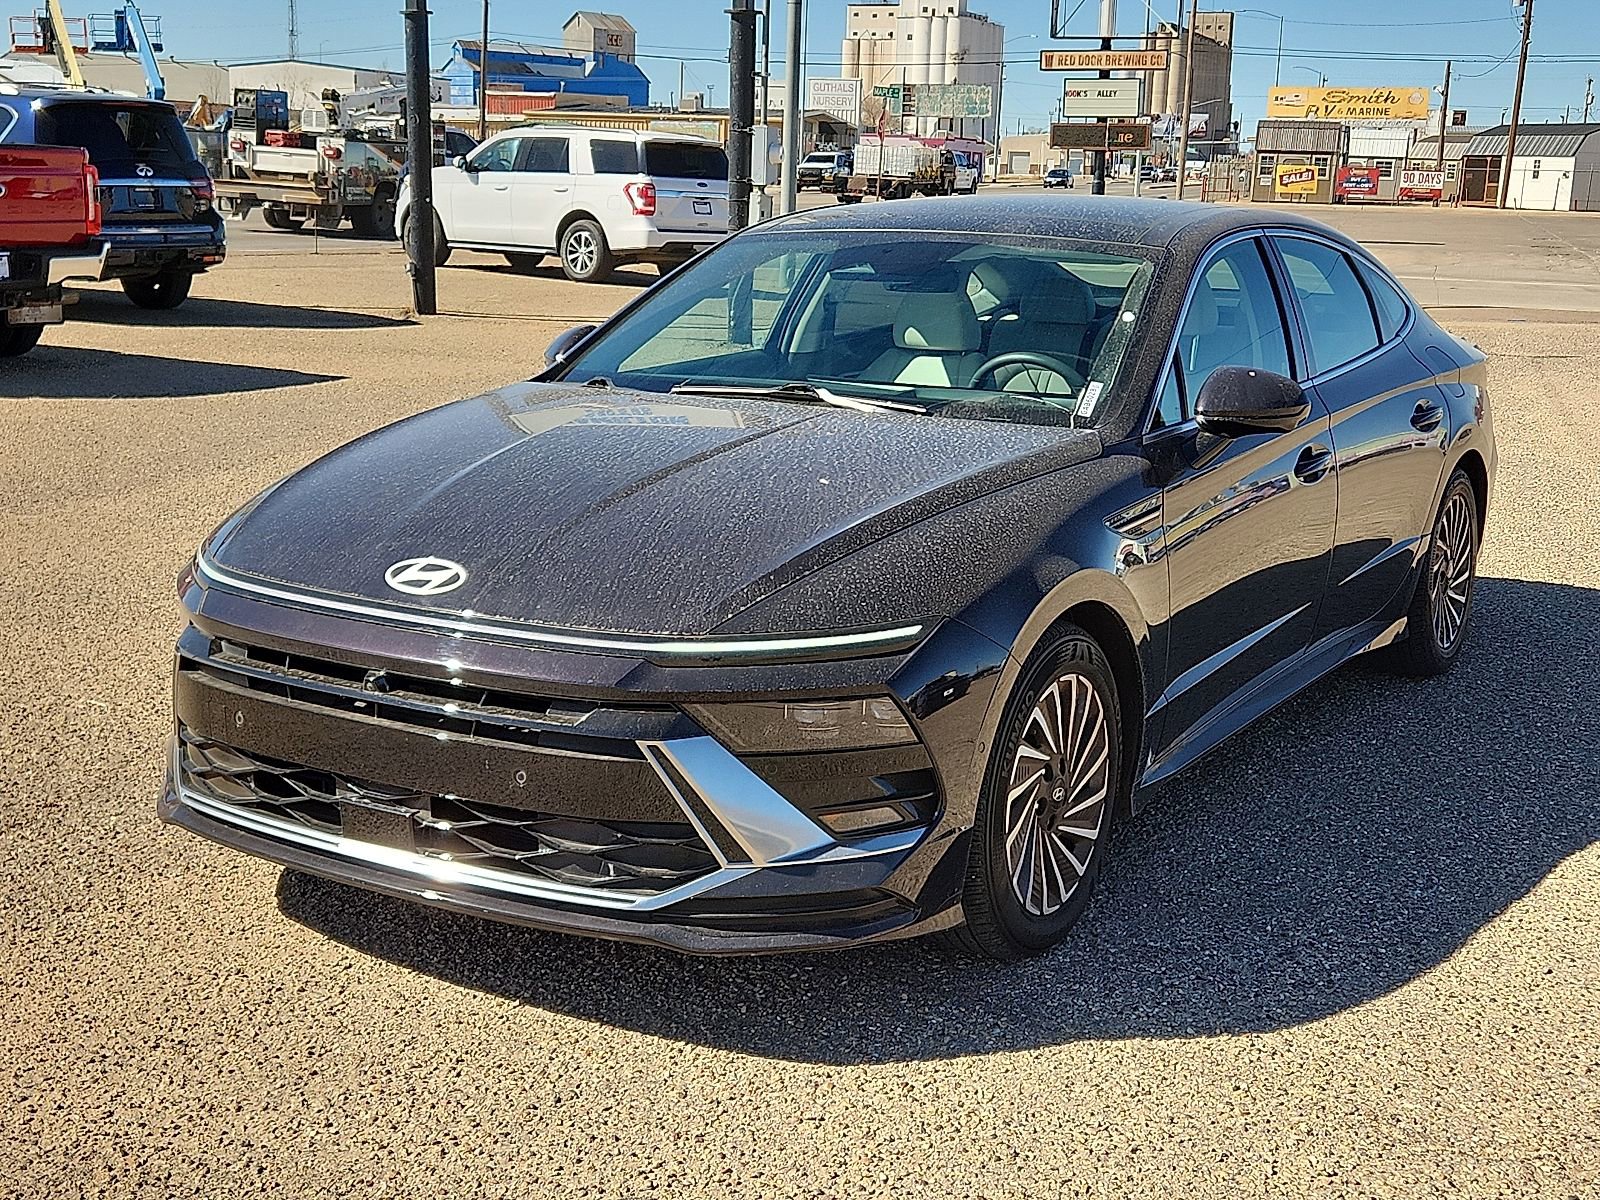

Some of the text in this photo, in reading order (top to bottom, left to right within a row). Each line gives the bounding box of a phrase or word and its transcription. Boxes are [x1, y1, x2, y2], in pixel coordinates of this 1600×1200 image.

[1058, 54, 1165, 66] RED DOOR BREWING CO.
[813, 82, 854, 92] GUTHALS
[874, 88, 893, 97] MAPLE
[1096, 90, 1118, 98] ALLEY
[1321, 88, 1401, 105] Smith
[812, 96, 853, 106] NURSERY
[1345, 107, 1391, 116] MARINE
[1282, 171, 1313, 185] SALE!
[1402, 172, 1442, 185] 90 DAYS
[1002, 690, 1033, 777] KUMHO
